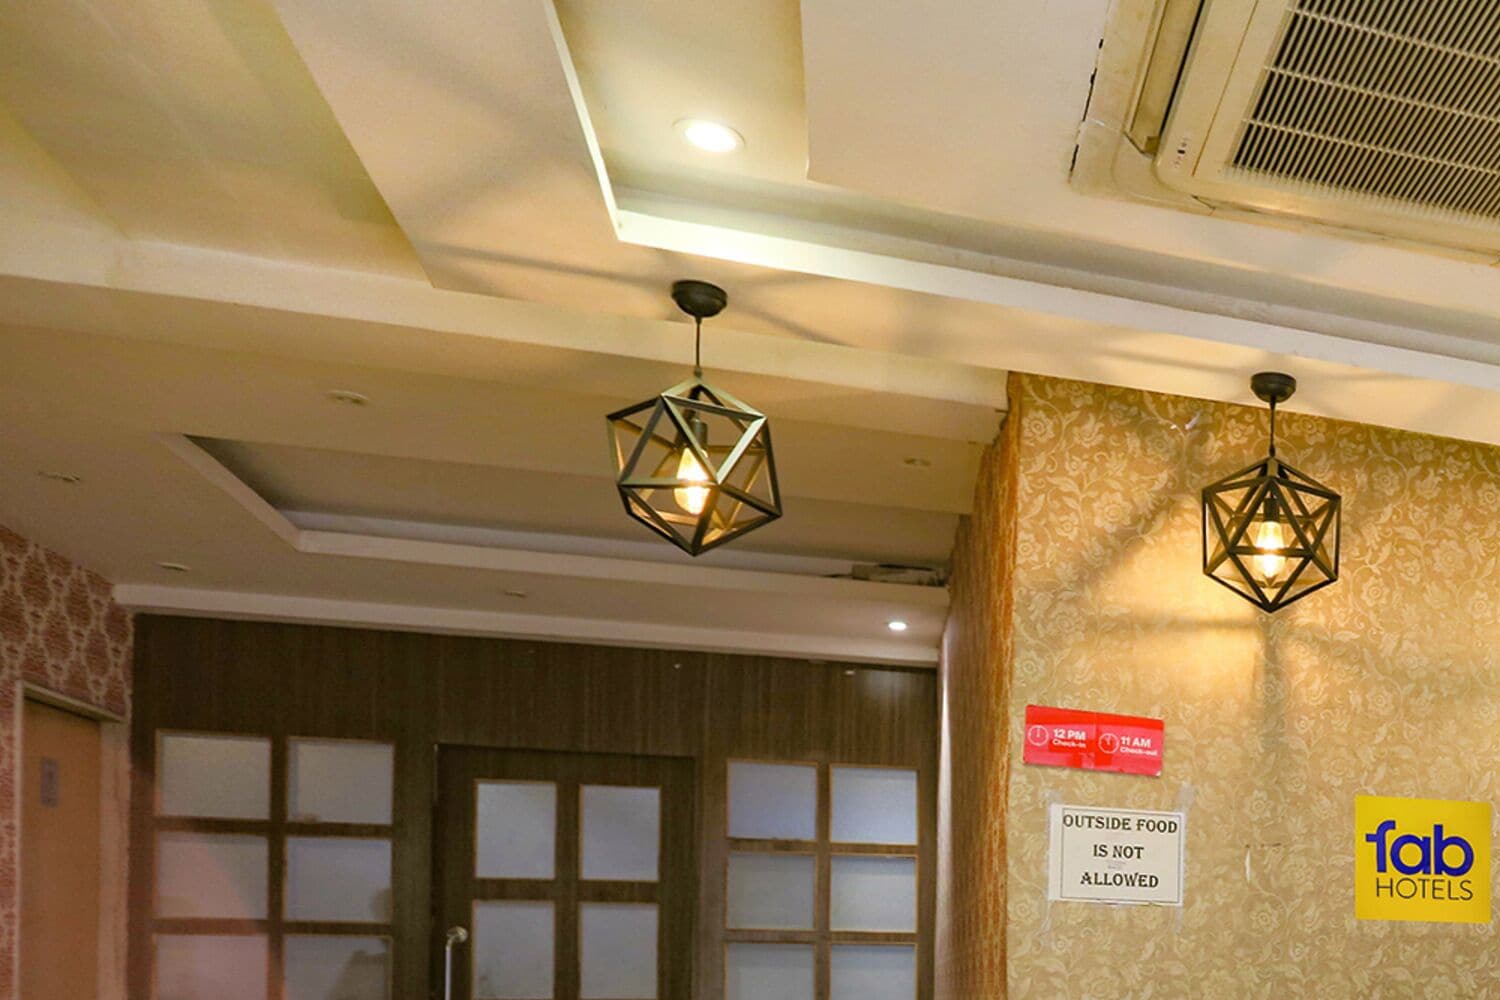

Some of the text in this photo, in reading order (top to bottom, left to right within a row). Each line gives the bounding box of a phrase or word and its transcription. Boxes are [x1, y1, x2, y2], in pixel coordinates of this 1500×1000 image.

[1053, 728, 1086, 740] 12 PM
[1120, 736, 1152, 748] 11 AM
[1063, 814, 1177, 834] OUTSIDE FOOD
[1093, 844, 1145, 859] IS NOT
[1365, 819, 1474, 876] fab
[1080, 871, 1159, 888] ALLOWED
[1376, 877, 1474, 901] HOTELS
